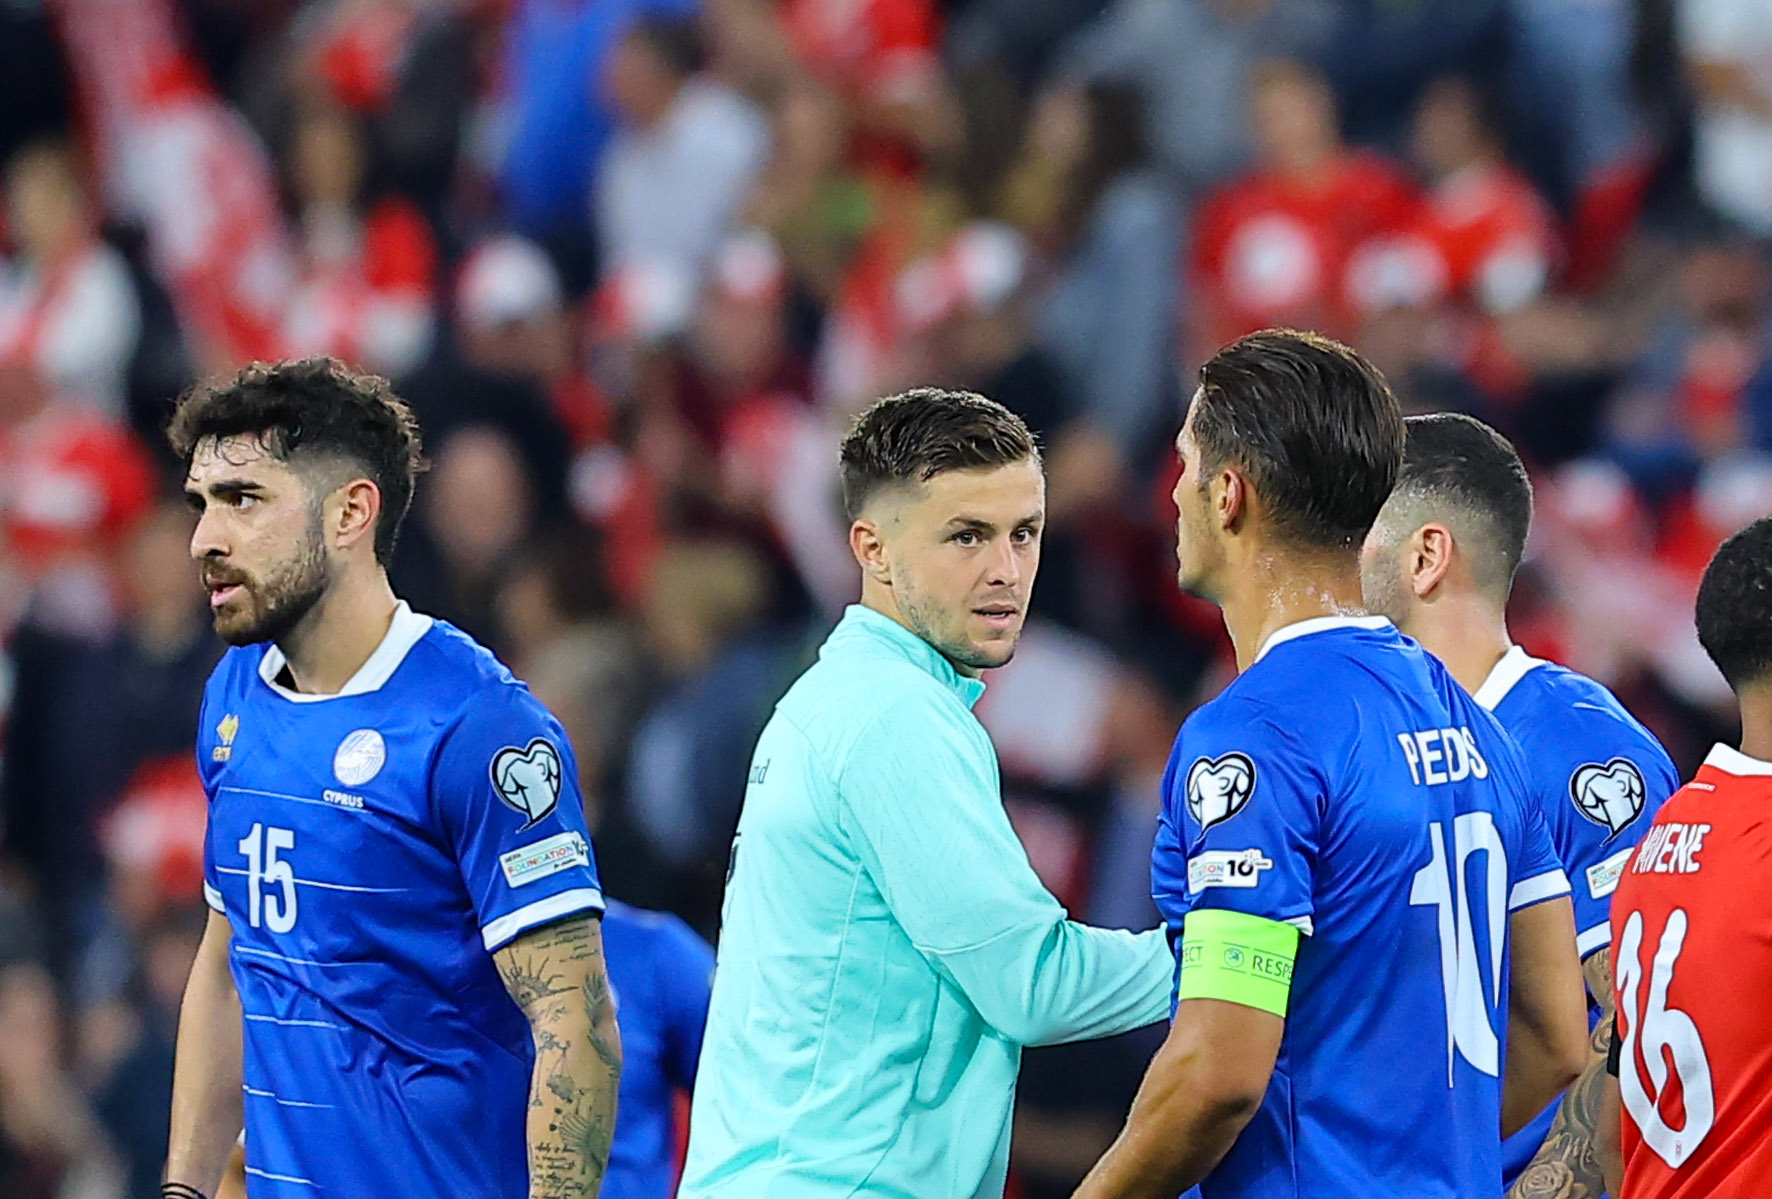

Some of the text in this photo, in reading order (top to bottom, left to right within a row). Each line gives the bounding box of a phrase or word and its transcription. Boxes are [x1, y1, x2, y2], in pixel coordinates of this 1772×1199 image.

[323, 789, 364, 809] CYPRUS
[239, 822, 298, 935] 15
[1411, 811, 1508, 1089] 10
